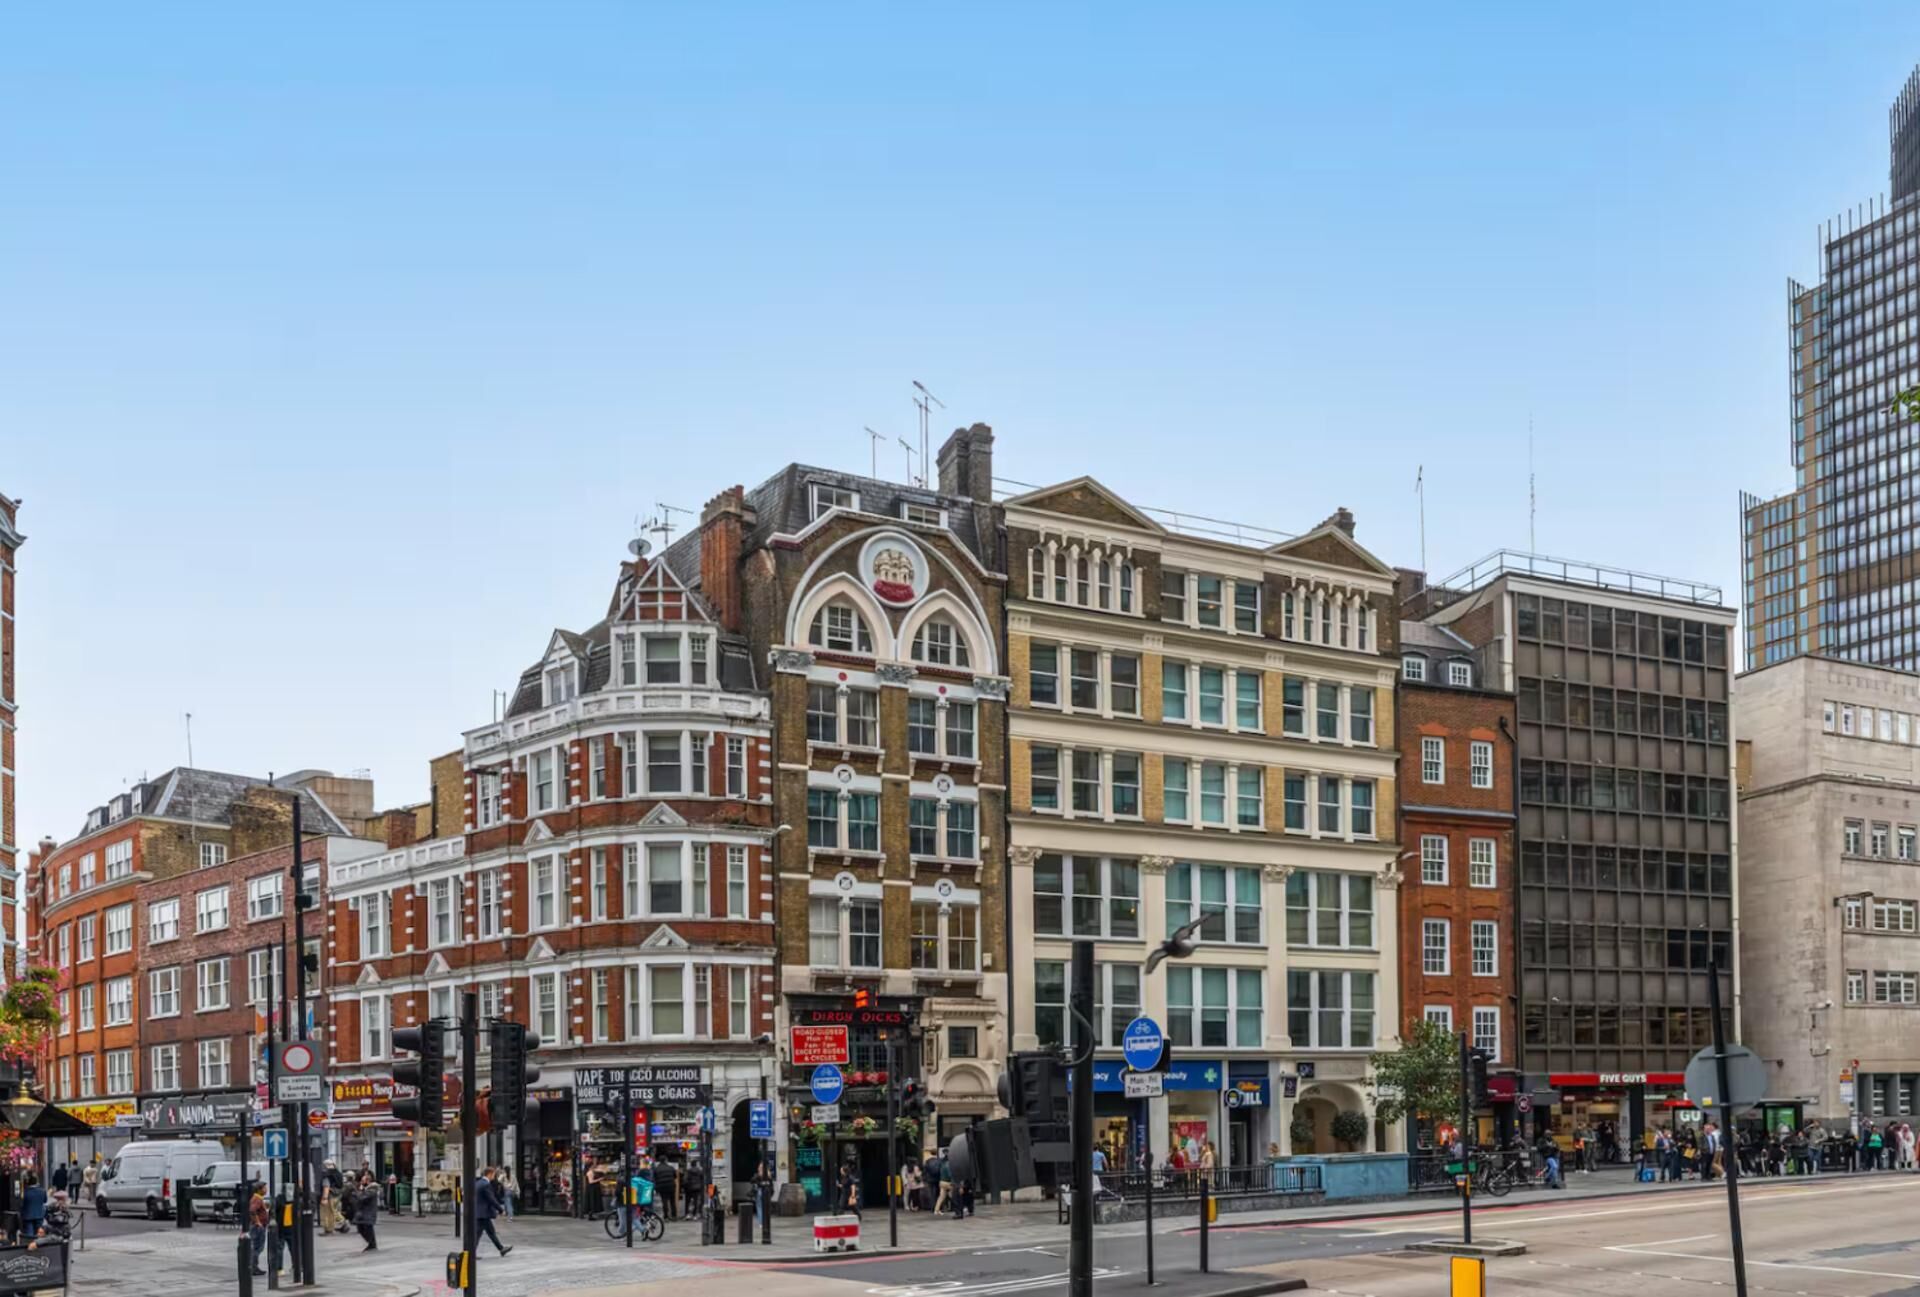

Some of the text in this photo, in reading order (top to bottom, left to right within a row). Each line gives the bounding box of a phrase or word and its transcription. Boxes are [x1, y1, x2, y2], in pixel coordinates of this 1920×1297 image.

[862, 1011, 901, 1022] DICKS
[576, 1069, 604, 1085] VAPE
[656, 1068, 700, 1081] ALCOHOL
[1600, 1073, 1647, 1083] FIVE GUYS
[373, 1083, 393, 1100] Hong
[578, 1086, 603, 1097] MOBILE
[658, 1087, 696, 1099] CIGARS
[179, 1104, 215, 1124] NANIWA
